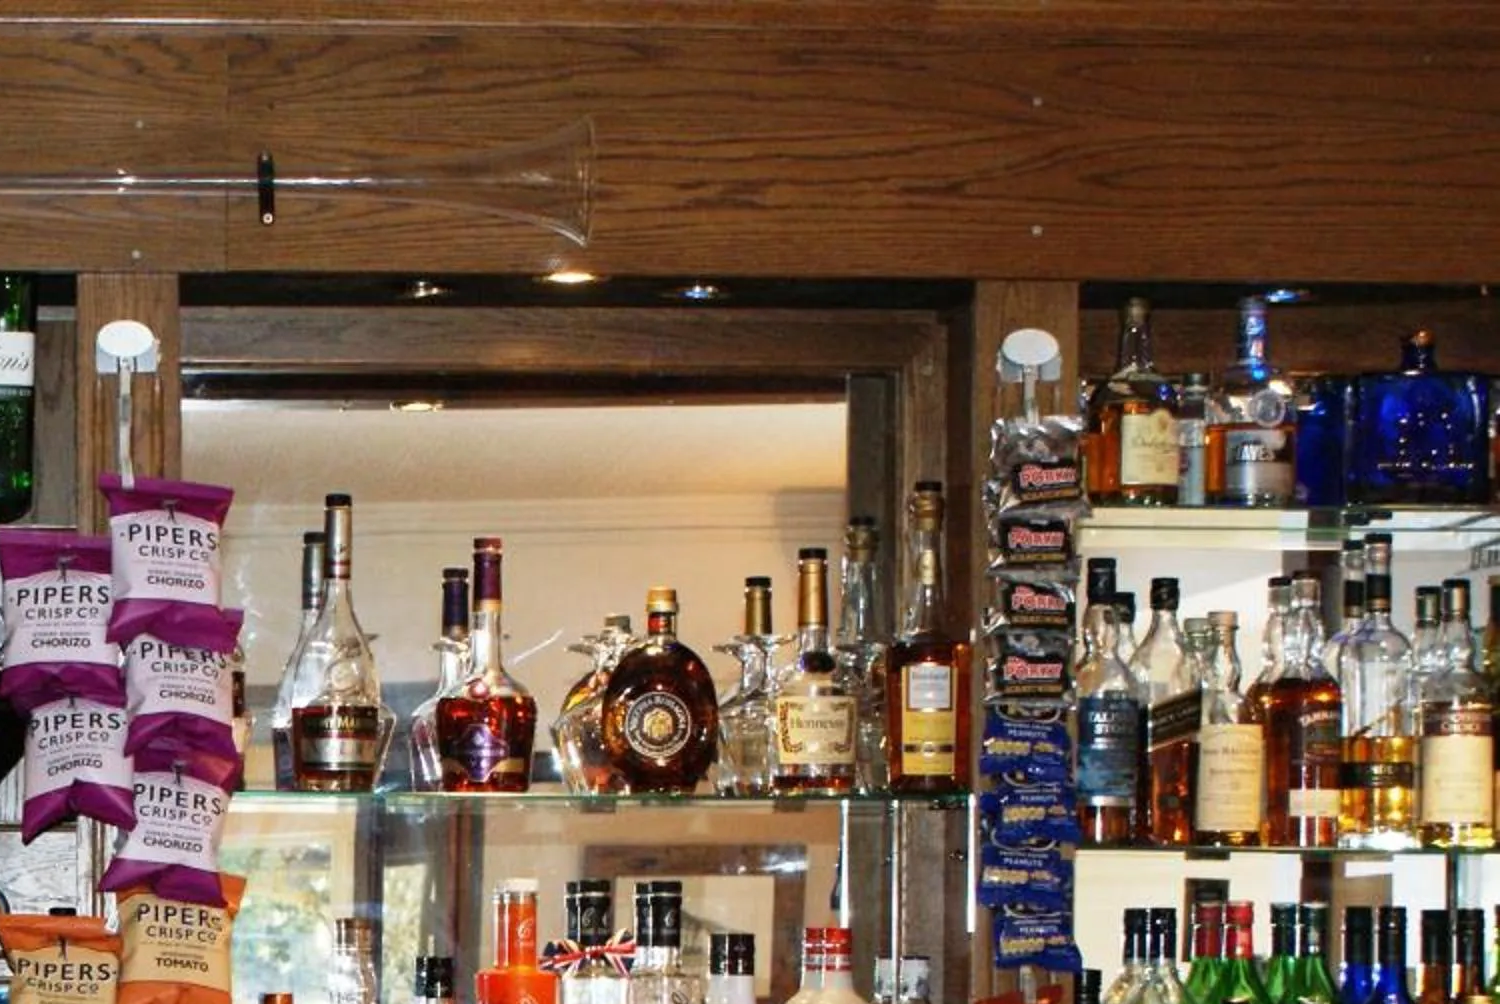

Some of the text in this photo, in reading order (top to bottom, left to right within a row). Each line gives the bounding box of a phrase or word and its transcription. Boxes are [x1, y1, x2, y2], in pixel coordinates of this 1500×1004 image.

[129, 524, 216, 550] PIPERS
[139, 546, 185, 558] CRISP
[147, 576, 204, 589] CHORIZO
[17, 585, 109, 605] PIPERS
[25, 607, 72, 618] CRISP
[31, 638, 90, 648] CHORIZO
[141, 642, 226, 668] PIPERS
[151, 661, 198, 673] CRISP
[159, 689, 215, 705] CHORIZO
[30, 713, 120, 736] PIPERS
[38, 732, 84, 750] CRISP
[47, 758, 103, 777] CHORIZO
[133, 783, 221, 816] PIPERS
[140, 806, 187, 821] CRISP
[143, 837, 203, 852] CHORIZO
[136, 903, 222, 932] PIPERS
[146, 925, 193, 940] CRISP
[17, 959, 110, 982] PIPERS
[156, 957, 208, 972] TOMATO
[26, 977, 72, 993] CRISP
